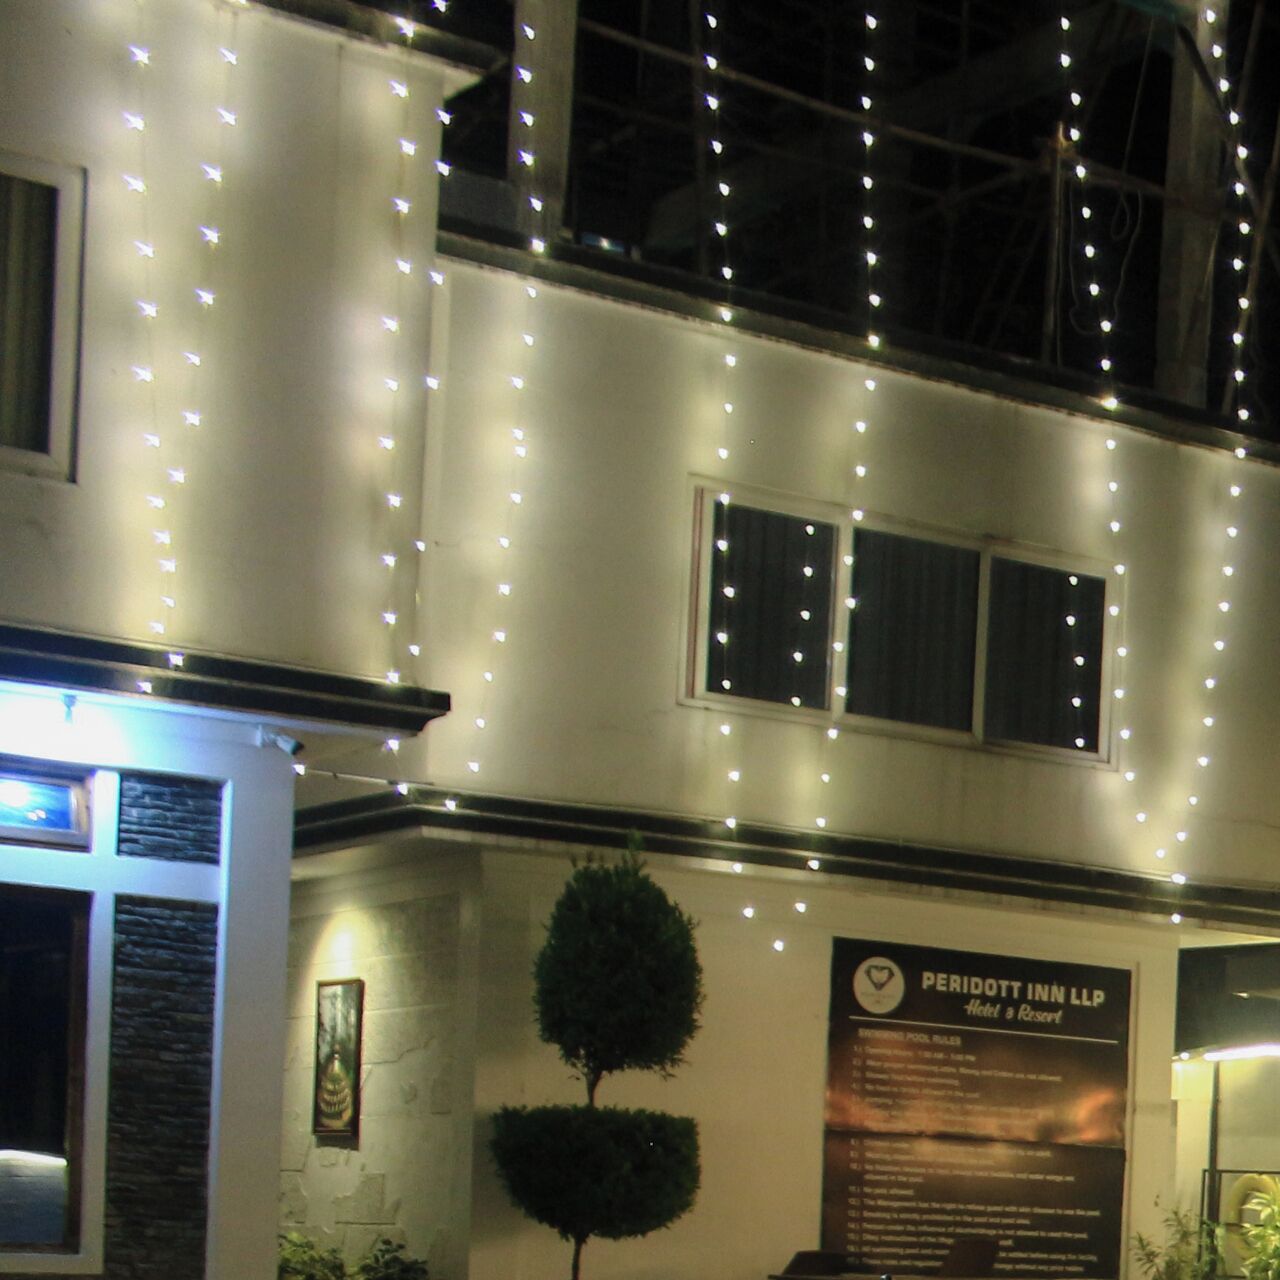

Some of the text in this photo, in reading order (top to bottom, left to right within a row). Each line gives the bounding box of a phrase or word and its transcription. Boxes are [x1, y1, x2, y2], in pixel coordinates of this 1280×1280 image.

[921, 970, 1022, 1000] PERIDOTT
[1027, 981, 1065, 1004] INN
[1069, 986, 1105, 1008] LLP
[963, 998, 1001, 1020] Hotel
[1017, 1003, 1063, 1025] Resort
[906, 1032, 931, 1044] POOL
[932, 1035, 962, 1047] RULES
